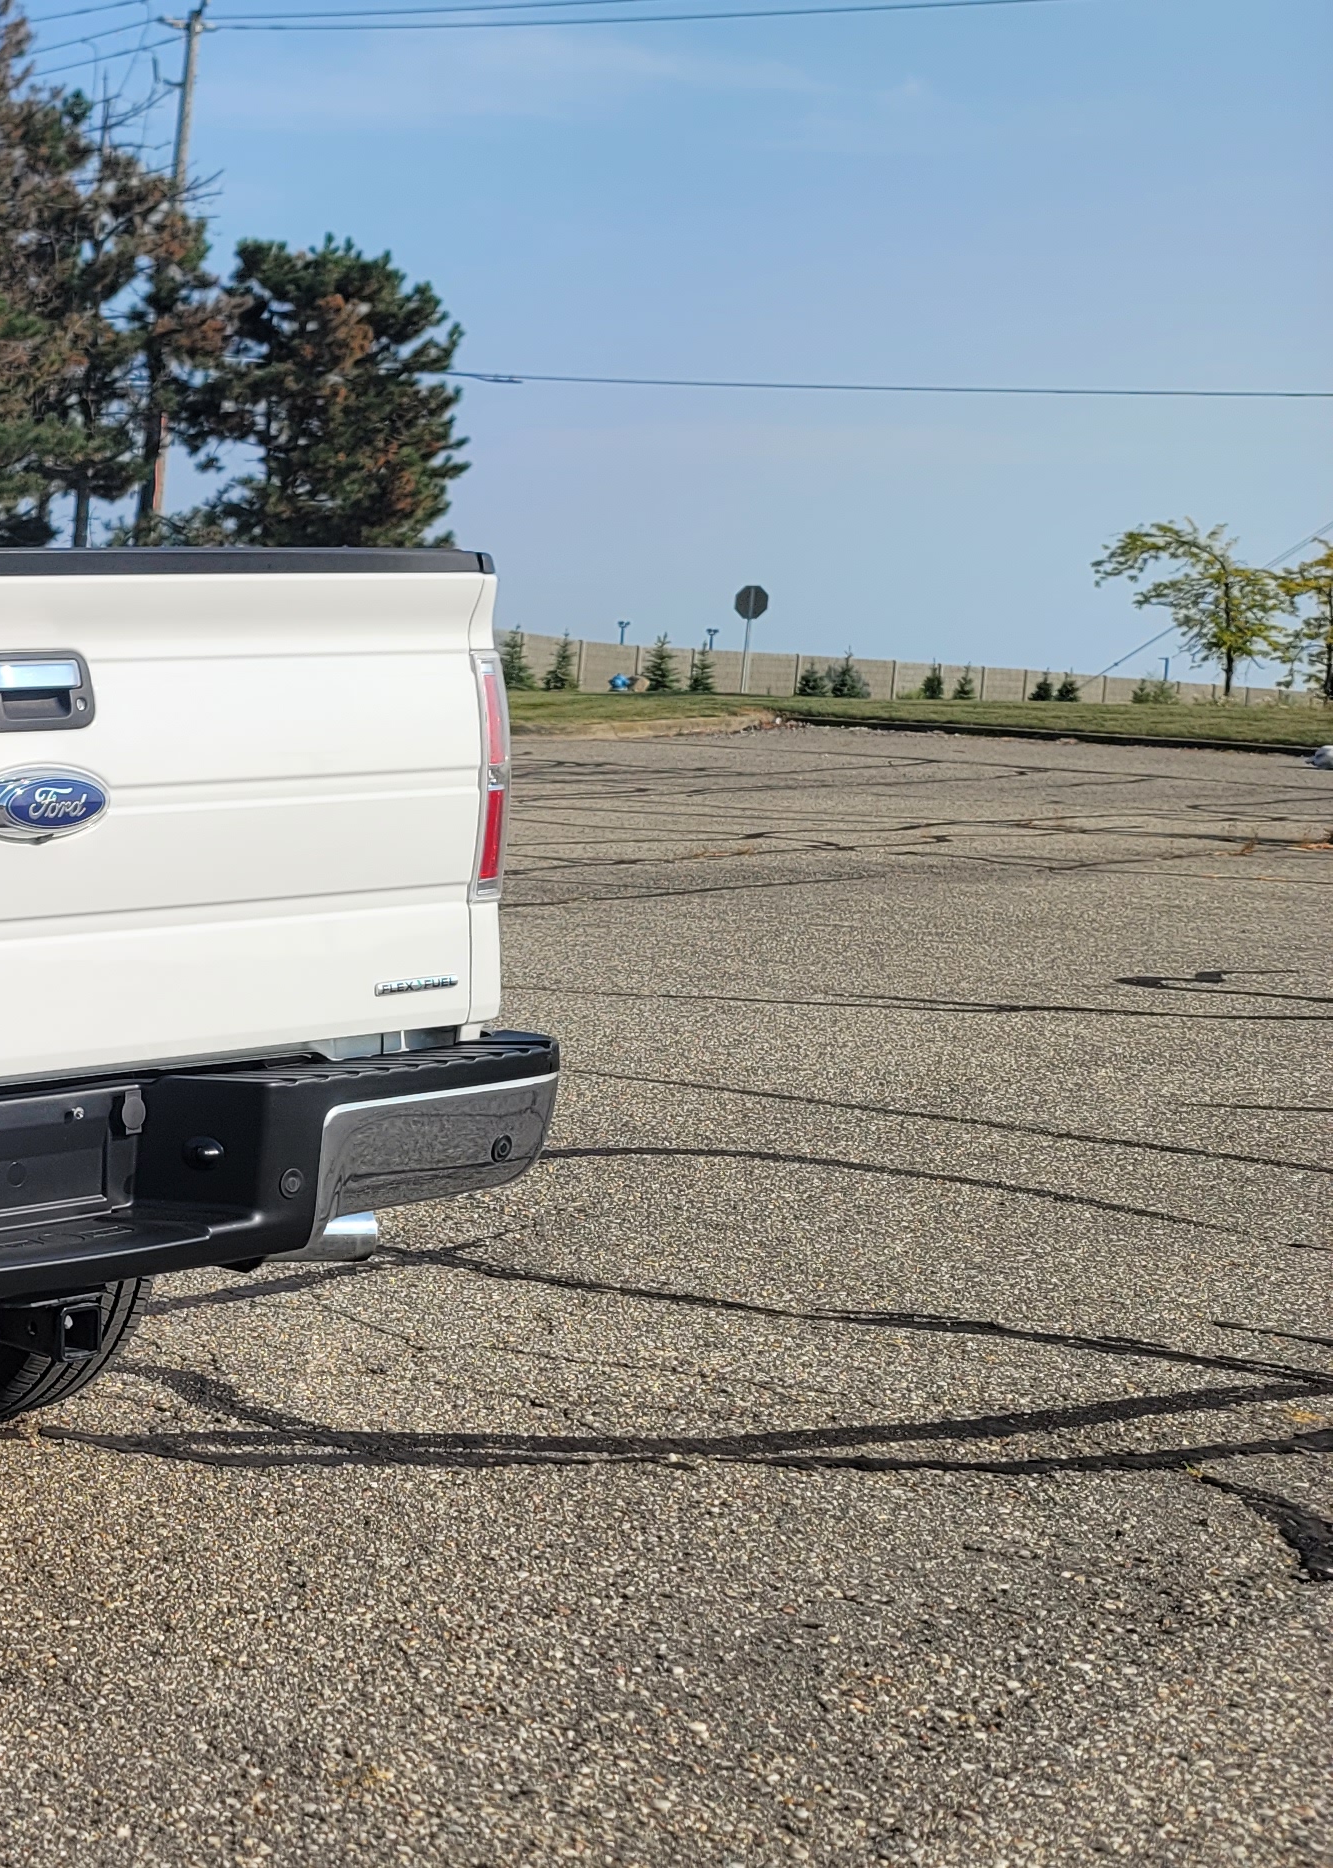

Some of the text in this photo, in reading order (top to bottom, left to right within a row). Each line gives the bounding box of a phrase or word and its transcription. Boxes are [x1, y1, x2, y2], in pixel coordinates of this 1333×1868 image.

[28, 786, 87, 819] Ford
[381, 976, 457, 994] FLEX FUEL
